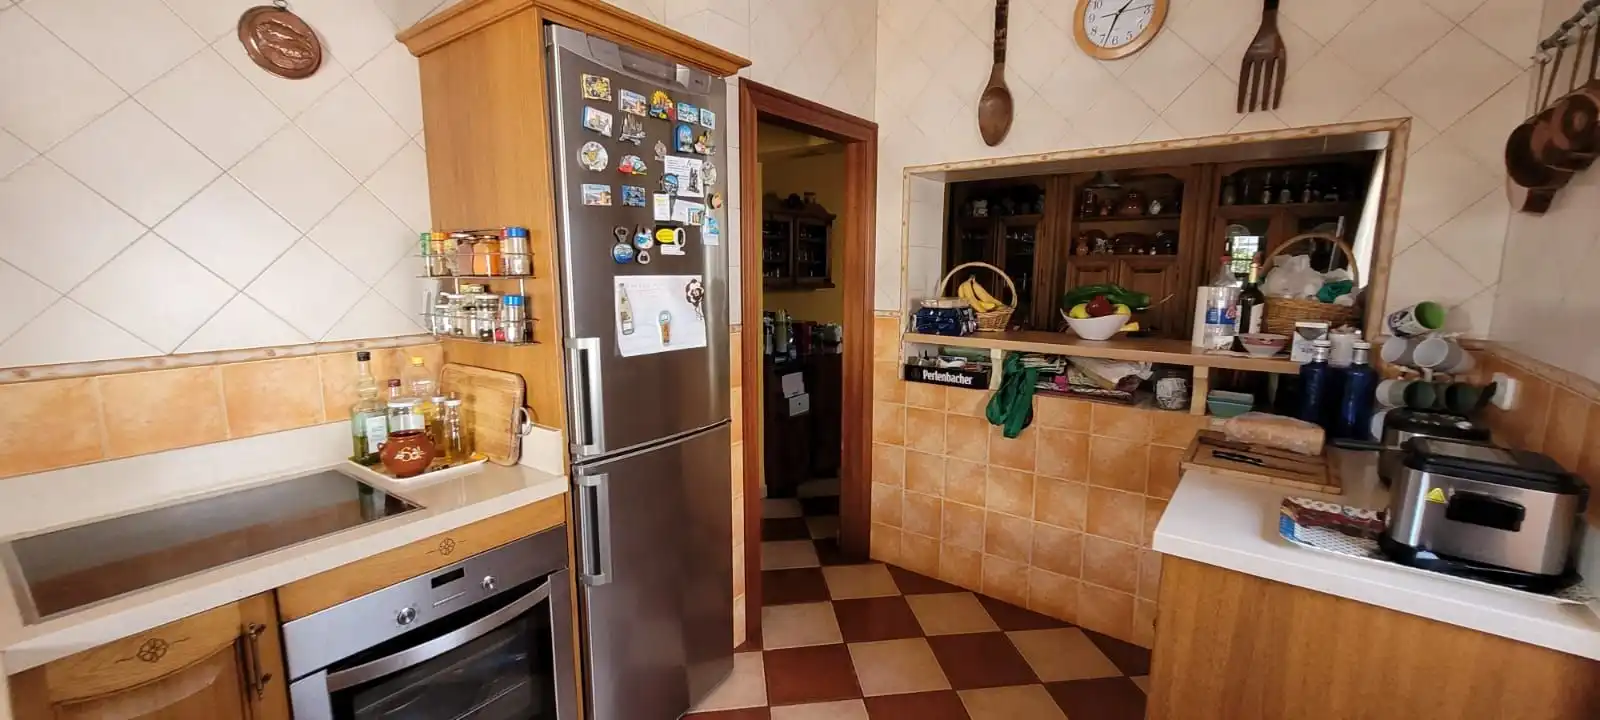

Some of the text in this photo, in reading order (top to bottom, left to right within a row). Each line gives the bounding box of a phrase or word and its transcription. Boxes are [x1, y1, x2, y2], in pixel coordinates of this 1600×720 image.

[1093, 1, 1103, 9] 10
[1088, 14, 1095, 23] 9
[1091, 27, 1098, 36] 8
[1126, 31, 1133, 40] 5
[1099, 34, 1106, 44] 7
[1111, 35, 1119, 45] 6
[922, 369, 974, 385] Perlenbacher
